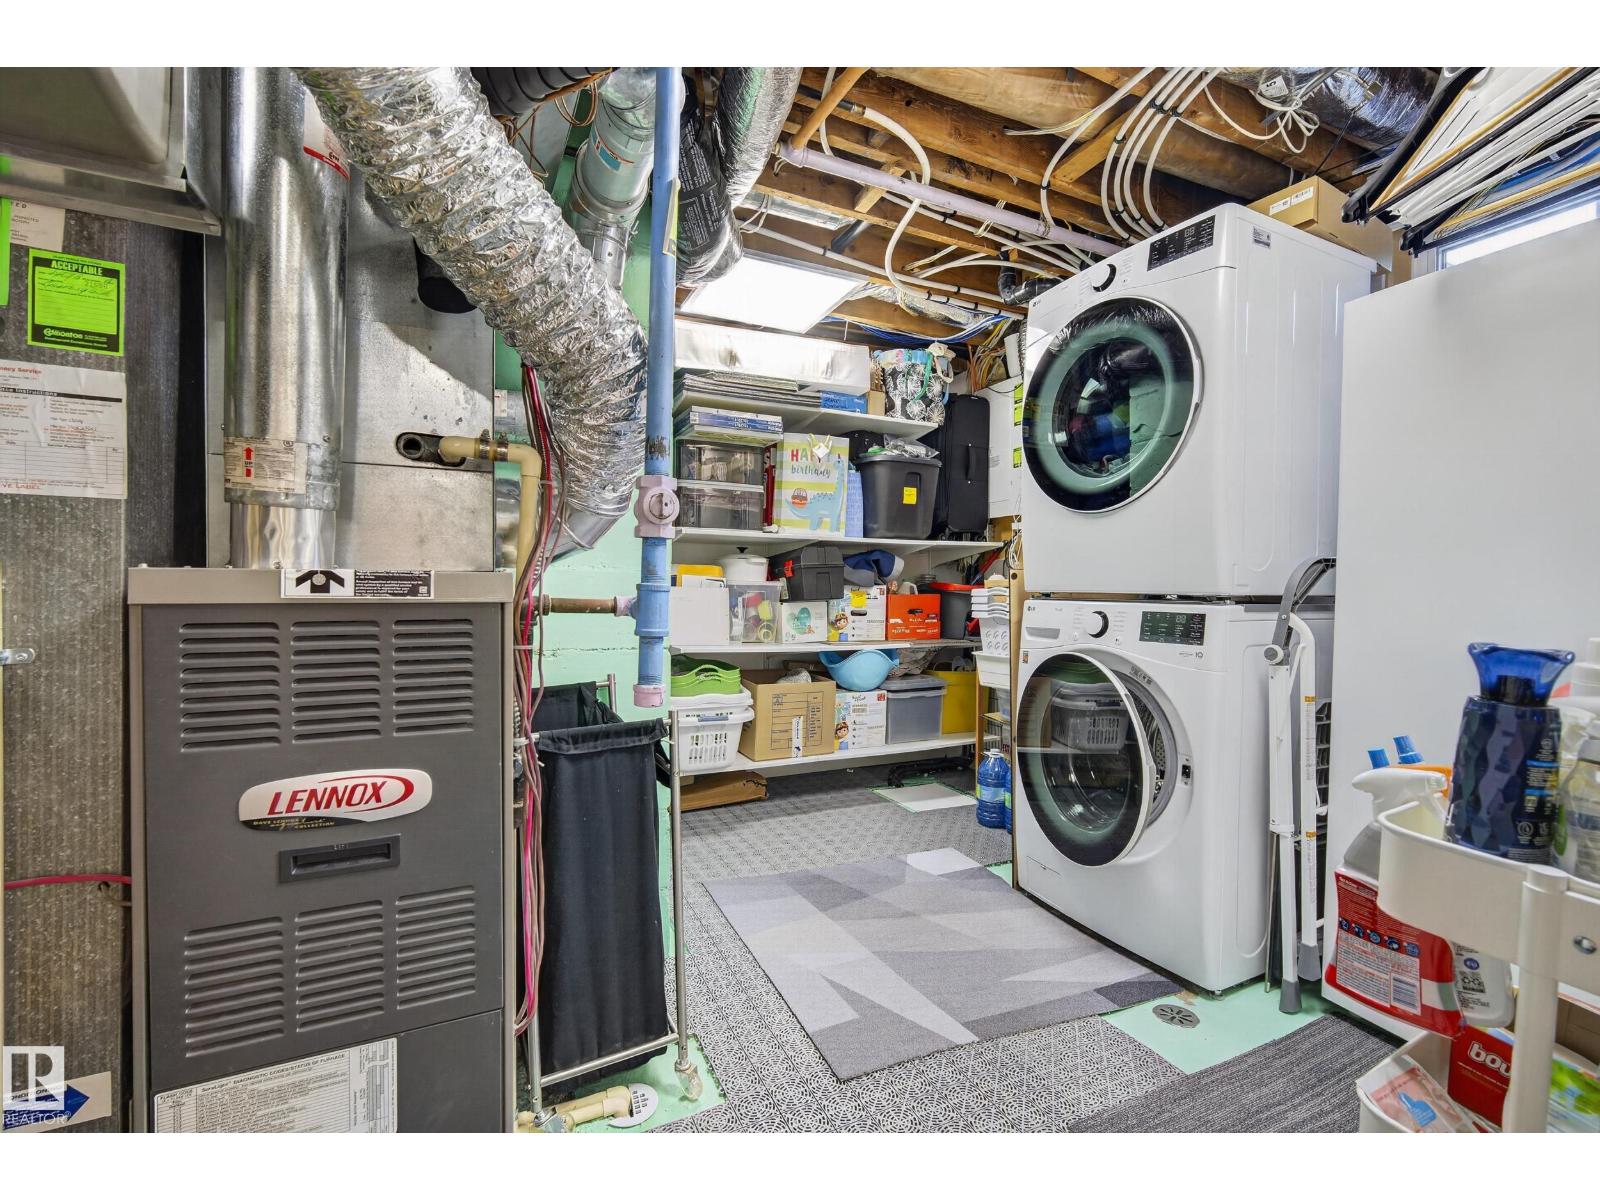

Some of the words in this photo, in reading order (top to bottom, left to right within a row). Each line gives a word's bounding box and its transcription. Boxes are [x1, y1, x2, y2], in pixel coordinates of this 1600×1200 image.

[51, 260, 103, 276] ACCEPTABLE
[43, 328, 84, 340] Edmonton
[791, 464, 831, 479] birthday
[267, 781, 388, 816] LENNOX
